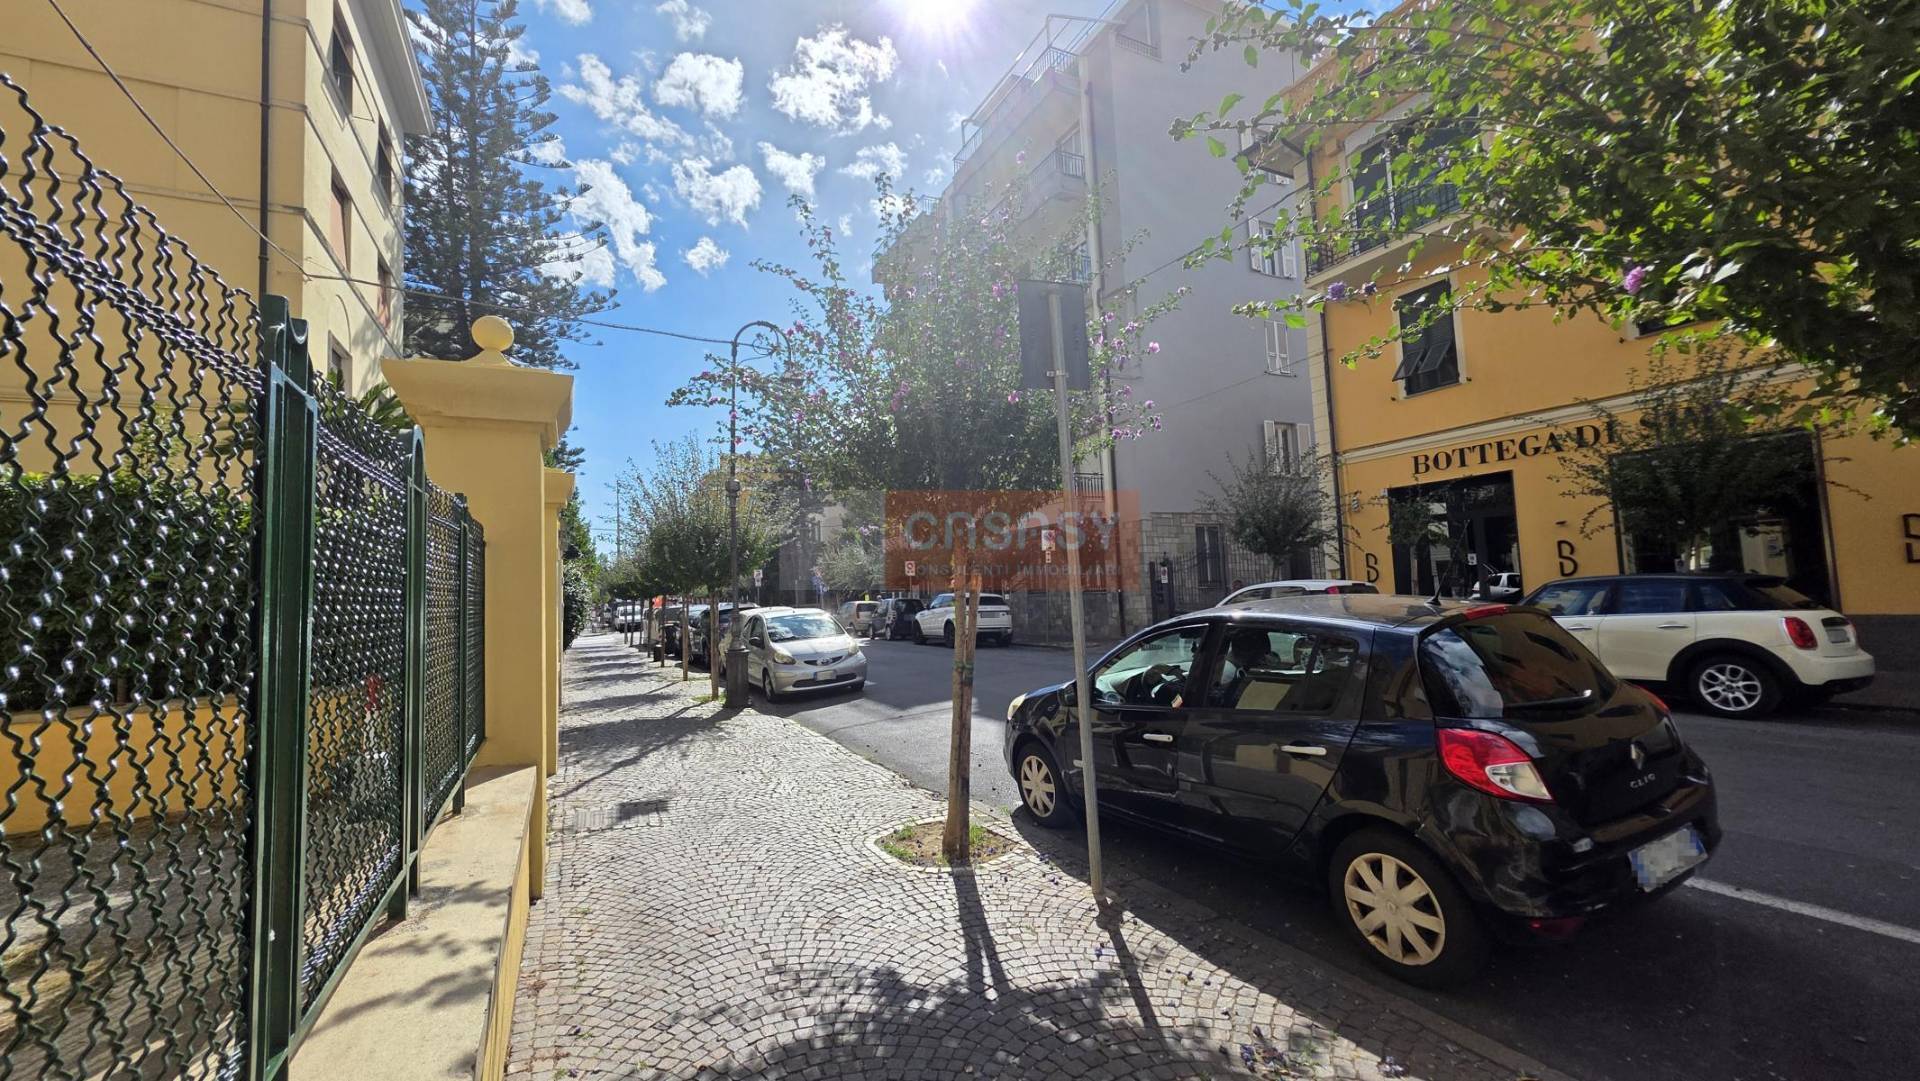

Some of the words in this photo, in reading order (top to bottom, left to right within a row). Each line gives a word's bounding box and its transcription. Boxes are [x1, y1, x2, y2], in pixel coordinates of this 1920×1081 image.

[1411, 431, 1564, 475] BOTTEGA
[1576, 418, 1616, 449] DI
[1629, 773, 1656, 789] CLIO
